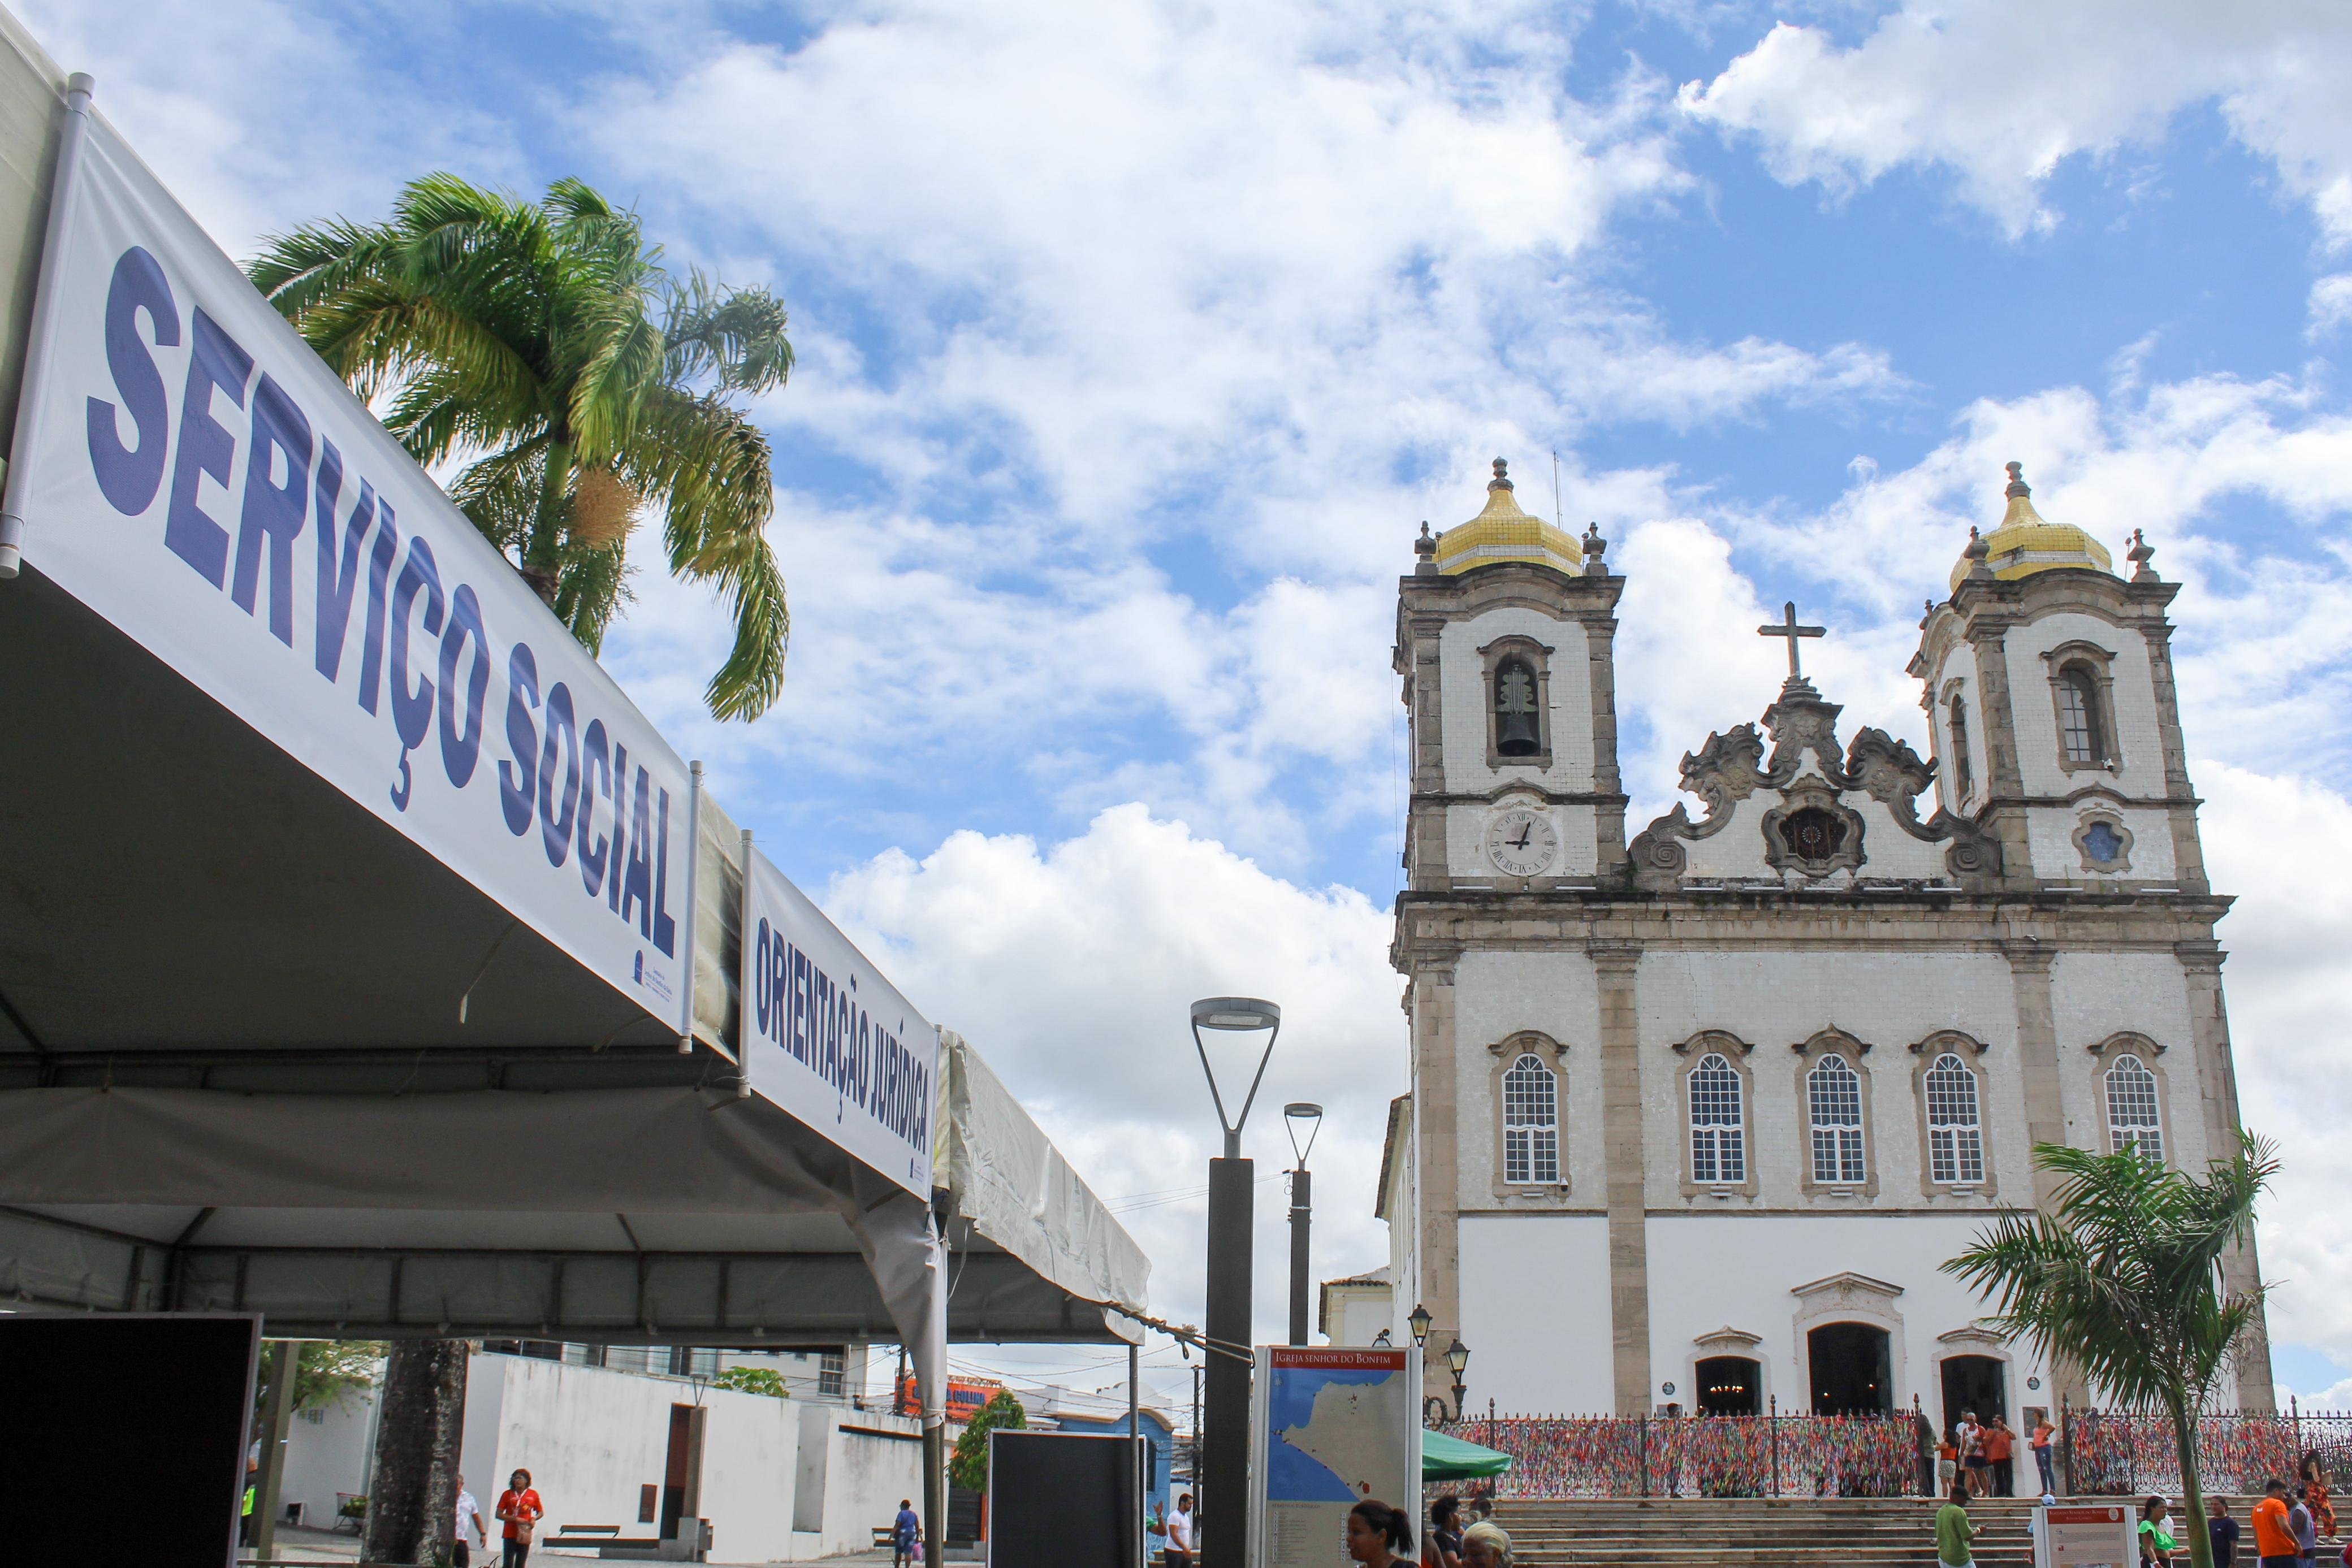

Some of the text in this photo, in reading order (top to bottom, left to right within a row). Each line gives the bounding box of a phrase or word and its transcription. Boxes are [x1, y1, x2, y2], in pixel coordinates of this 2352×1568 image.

[87, 246, 675, 960] SERVIÇO SOCIAL
[1517, 813, 1525, 822] XII
[756, 917, 929, 1155] ORIENTAÇÃO JURÍDICA
